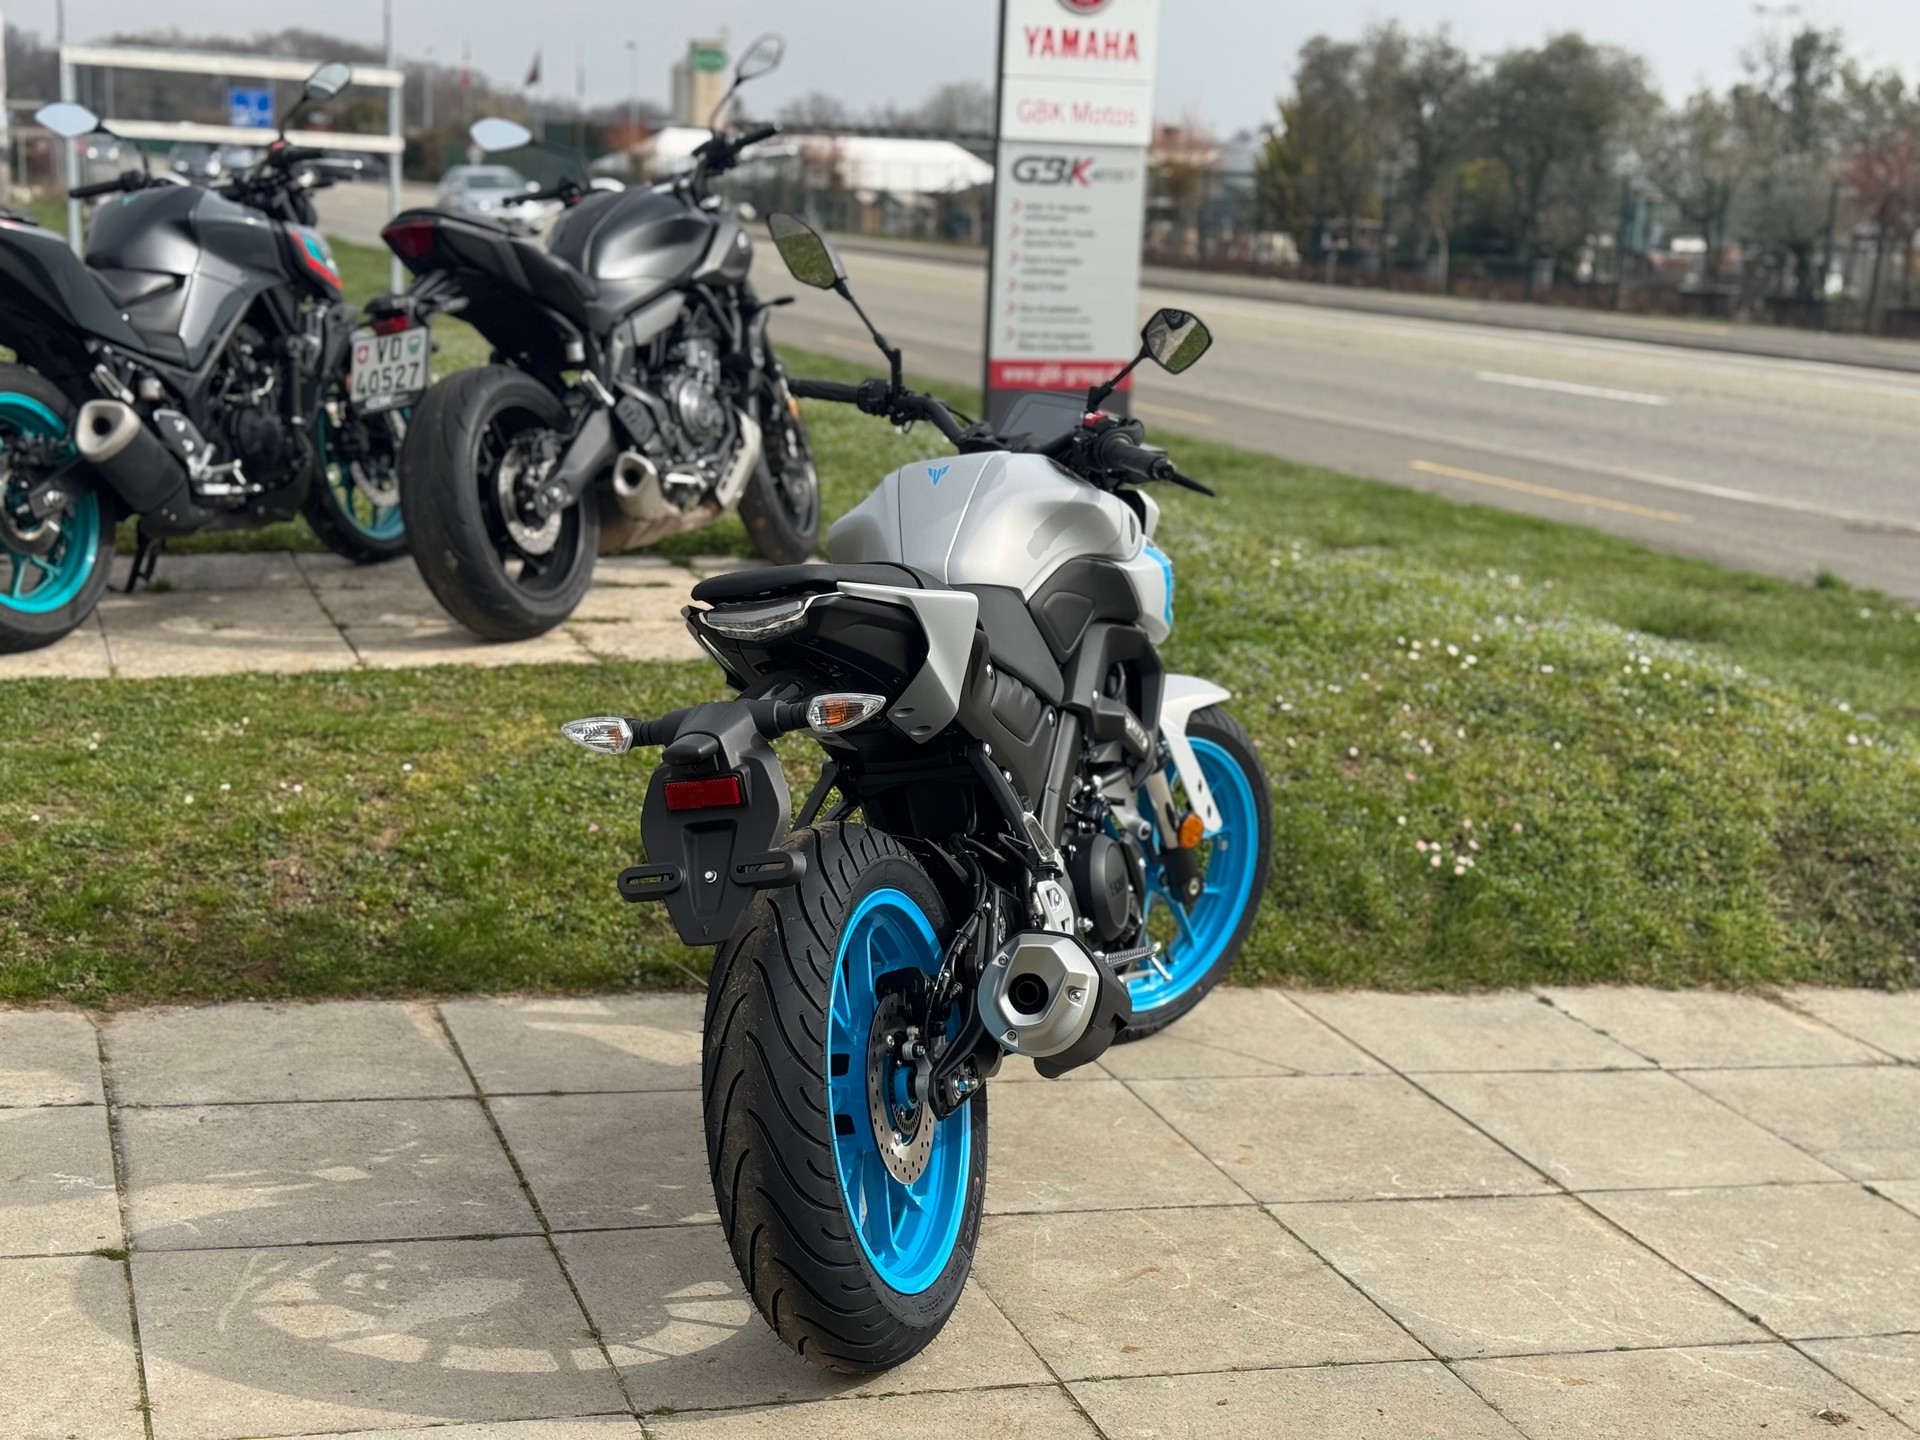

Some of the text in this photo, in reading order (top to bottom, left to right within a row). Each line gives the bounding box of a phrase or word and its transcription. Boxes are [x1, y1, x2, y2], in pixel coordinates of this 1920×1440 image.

[1024, 27, 1138, 60] YAMAHA
[1017, 100, 1063, 123] GBK
[1012, 155, 1094, 187] GBK
[377, 336, 402, 364] VD
[355, 362, 420, 394] 40527
